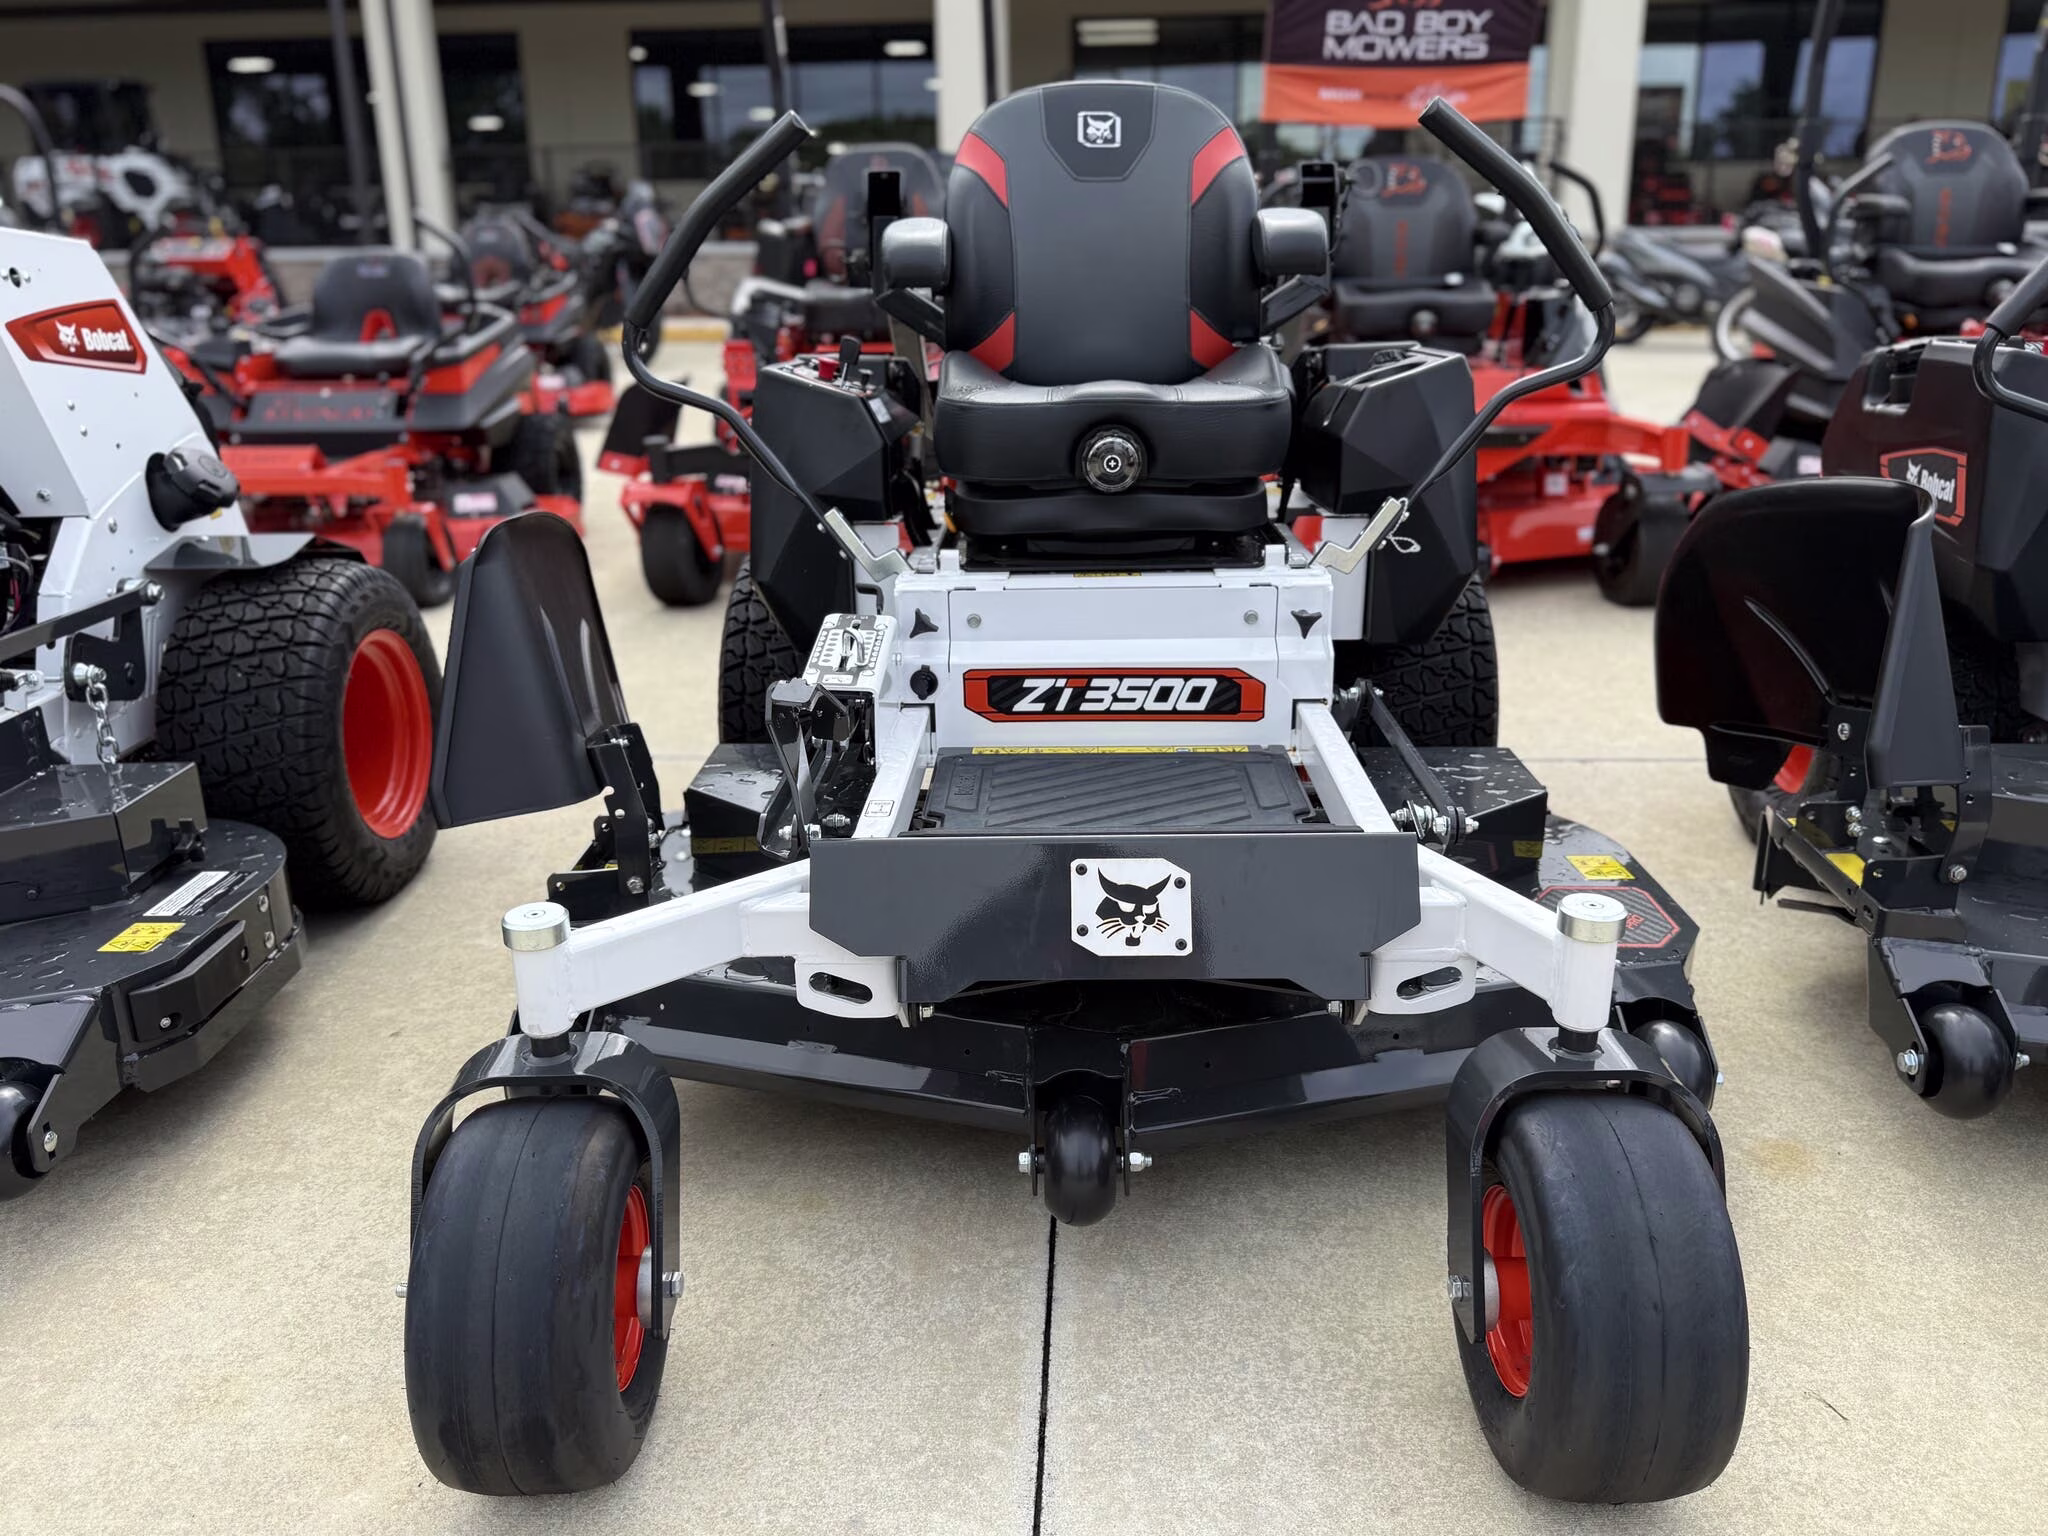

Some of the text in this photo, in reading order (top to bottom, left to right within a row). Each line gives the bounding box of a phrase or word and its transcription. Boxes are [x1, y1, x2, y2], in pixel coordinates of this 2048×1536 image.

[1325, 9, 1493, 35] BAD BOY
[1322, 34, 1489, 61] MOWERS
[80, 327, 132, 352] Bobcat
[1920, 469, 1955, 503] Bobcat
